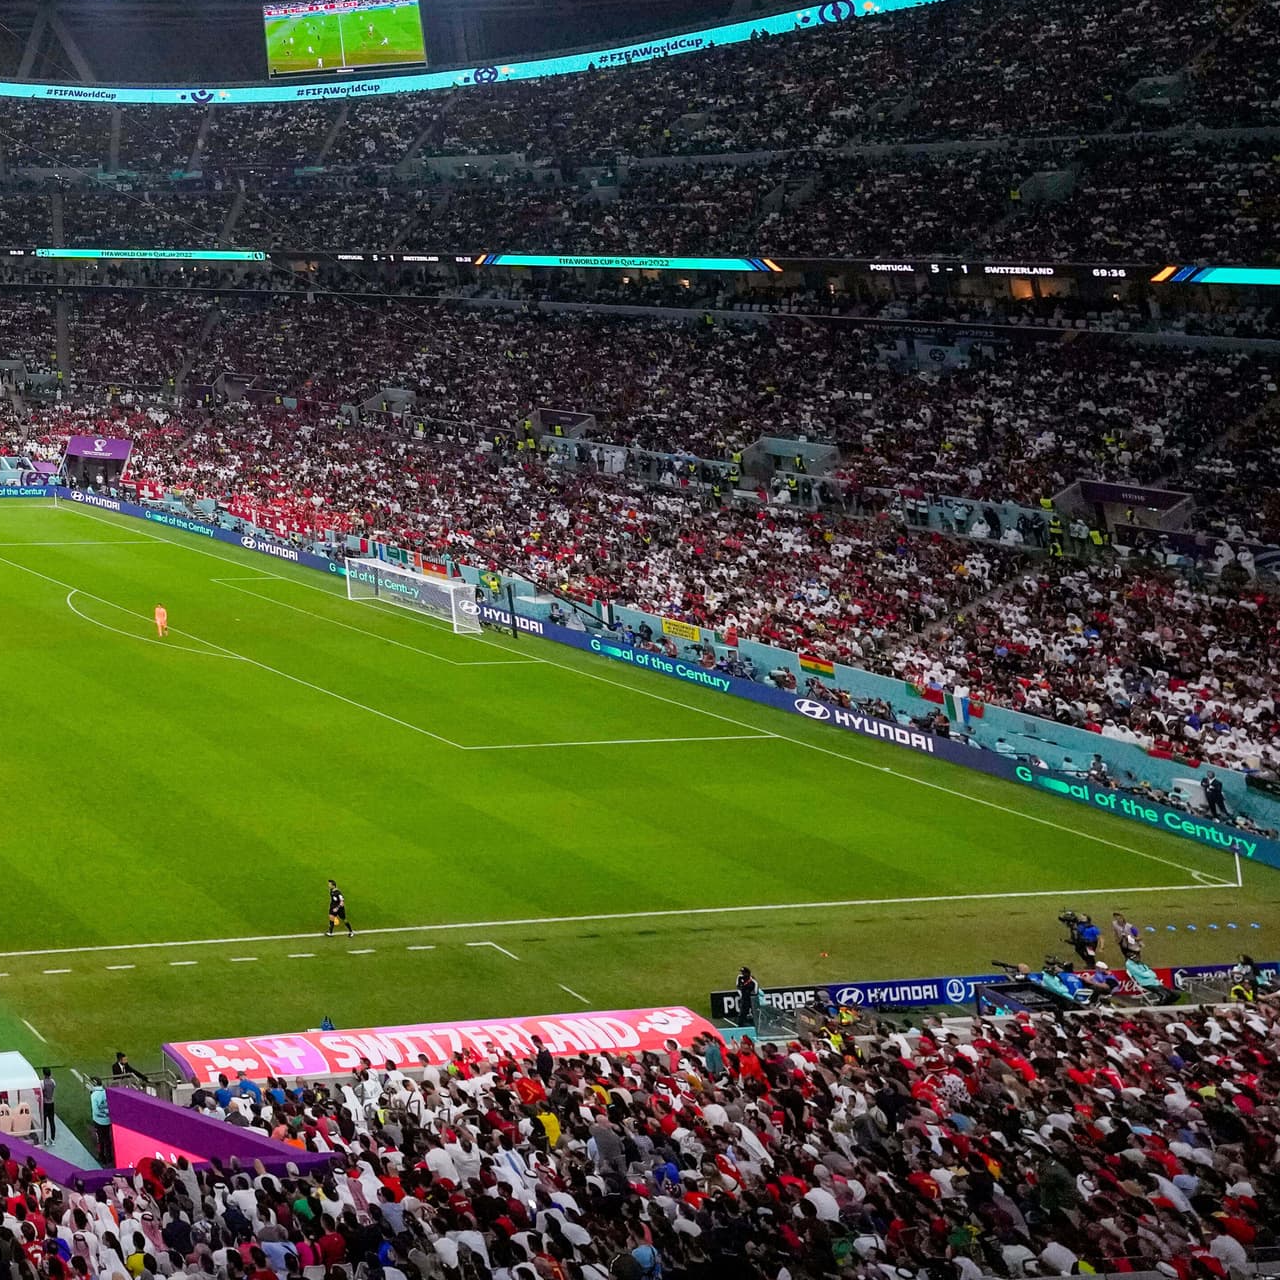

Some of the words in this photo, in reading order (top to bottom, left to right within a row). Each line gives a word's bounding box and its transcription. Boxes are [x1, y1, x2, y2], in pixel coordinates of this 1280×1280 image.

[598, 37, 704, 64] #FIFAWorldCup
[46, 89, 117, 100] #FIFAWorldCup
[297, 84, 381, 97] #FIFAWorldCup
[869, 264, 914, 272] PORTUGAL
[931, 264, 939, 273] 5
[984, 266, 1053, 275] SWITZERLAND
[1093, 268, 1126, 278] 69:36
[258, 541, 299, 561] HYUNDAI
[636, 653, 649, 667] of
[652, 657, 673, 673] the
[676, 664, 730, 692] Century
[835, 709, 935, 753] HYUNDAI
[1095, 793, 1116, 809] of
[1121, 799, 1159, 822] the
[1164, 813, 1257, 858] Century
[867, 985, 939, 1003] HYUNDAI
[322, 1016, 641, 1070] SWITZERLAND
